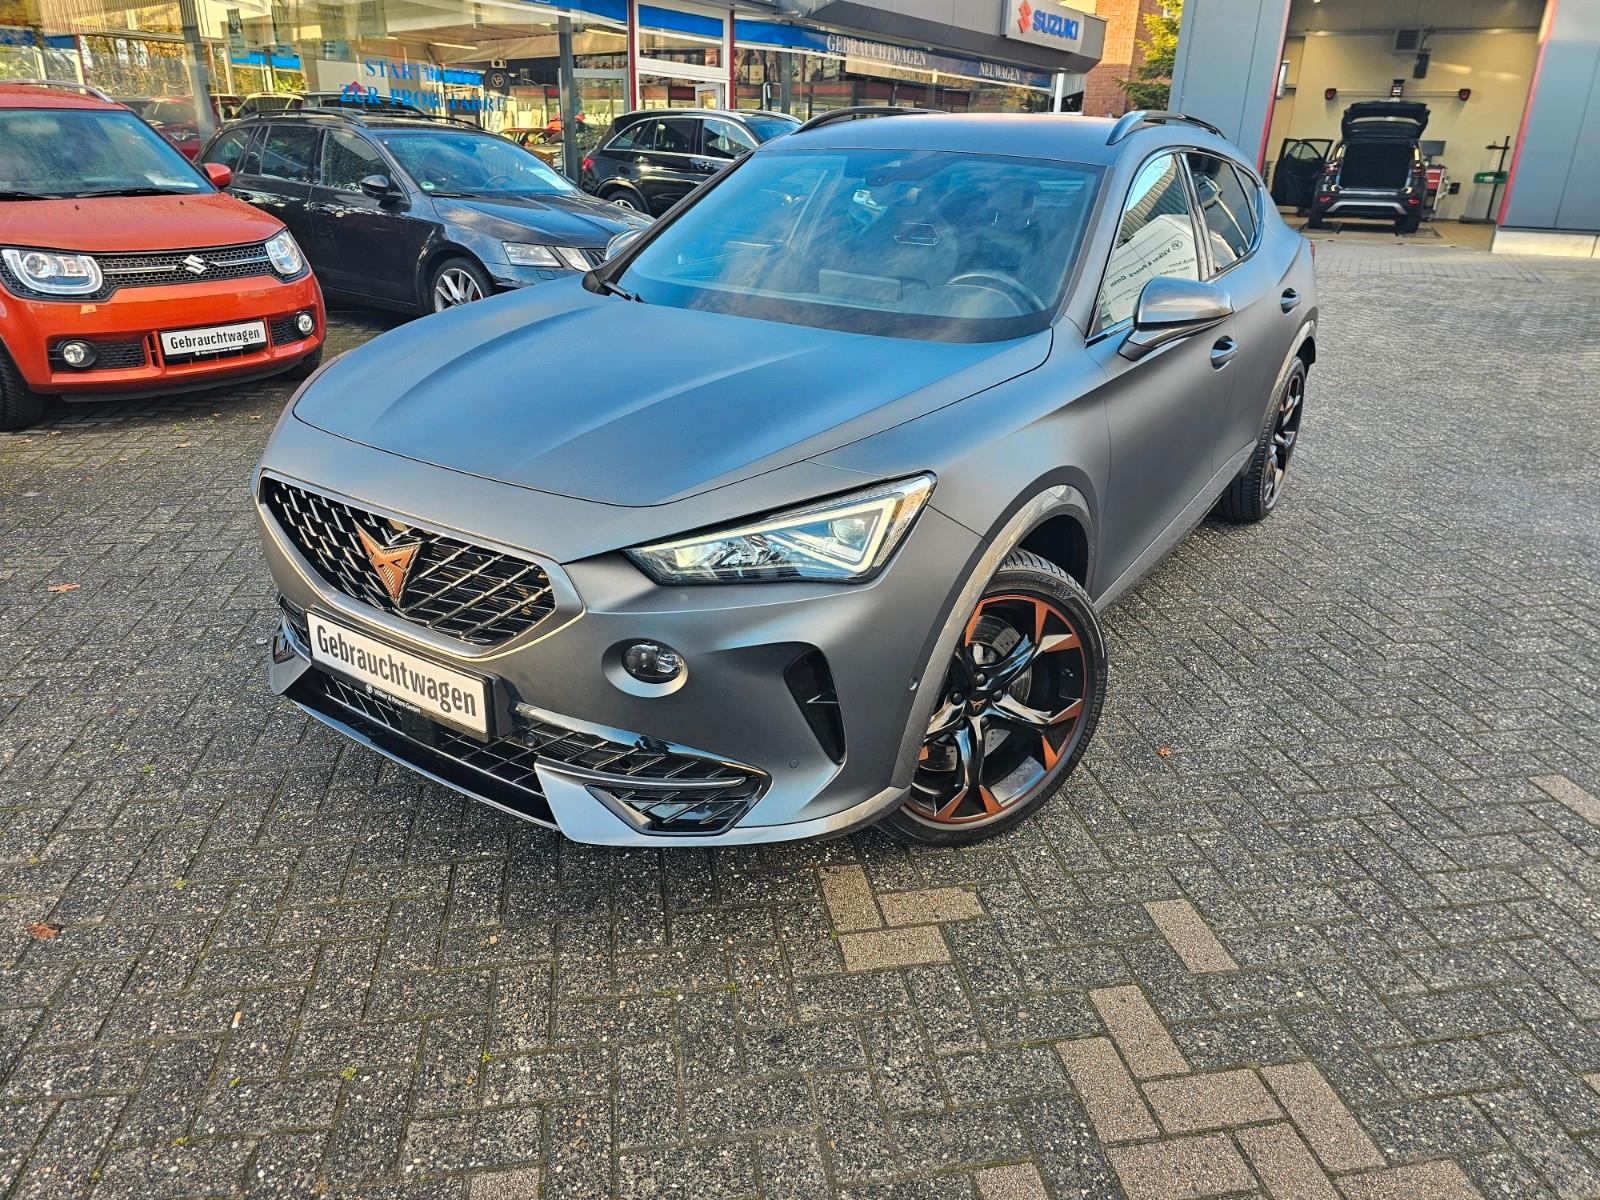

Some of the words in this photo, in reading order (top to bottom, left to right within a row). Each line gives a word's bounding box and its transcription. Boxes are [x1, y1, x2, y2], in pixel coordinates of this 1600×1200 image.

[1033, 10, 1079, 40] SUZUKI
[826, 34, 928, 67] GEBRAUCHTWAGEN
[978, 61, 1020, 81] NEUWAGEN
[170, 329, 260, 350] Gebrauchtwagen
[317, 624, 477, 717] Gebrauchtwagen
[1072, 668, 1106, 762] BRIDGESTONE
